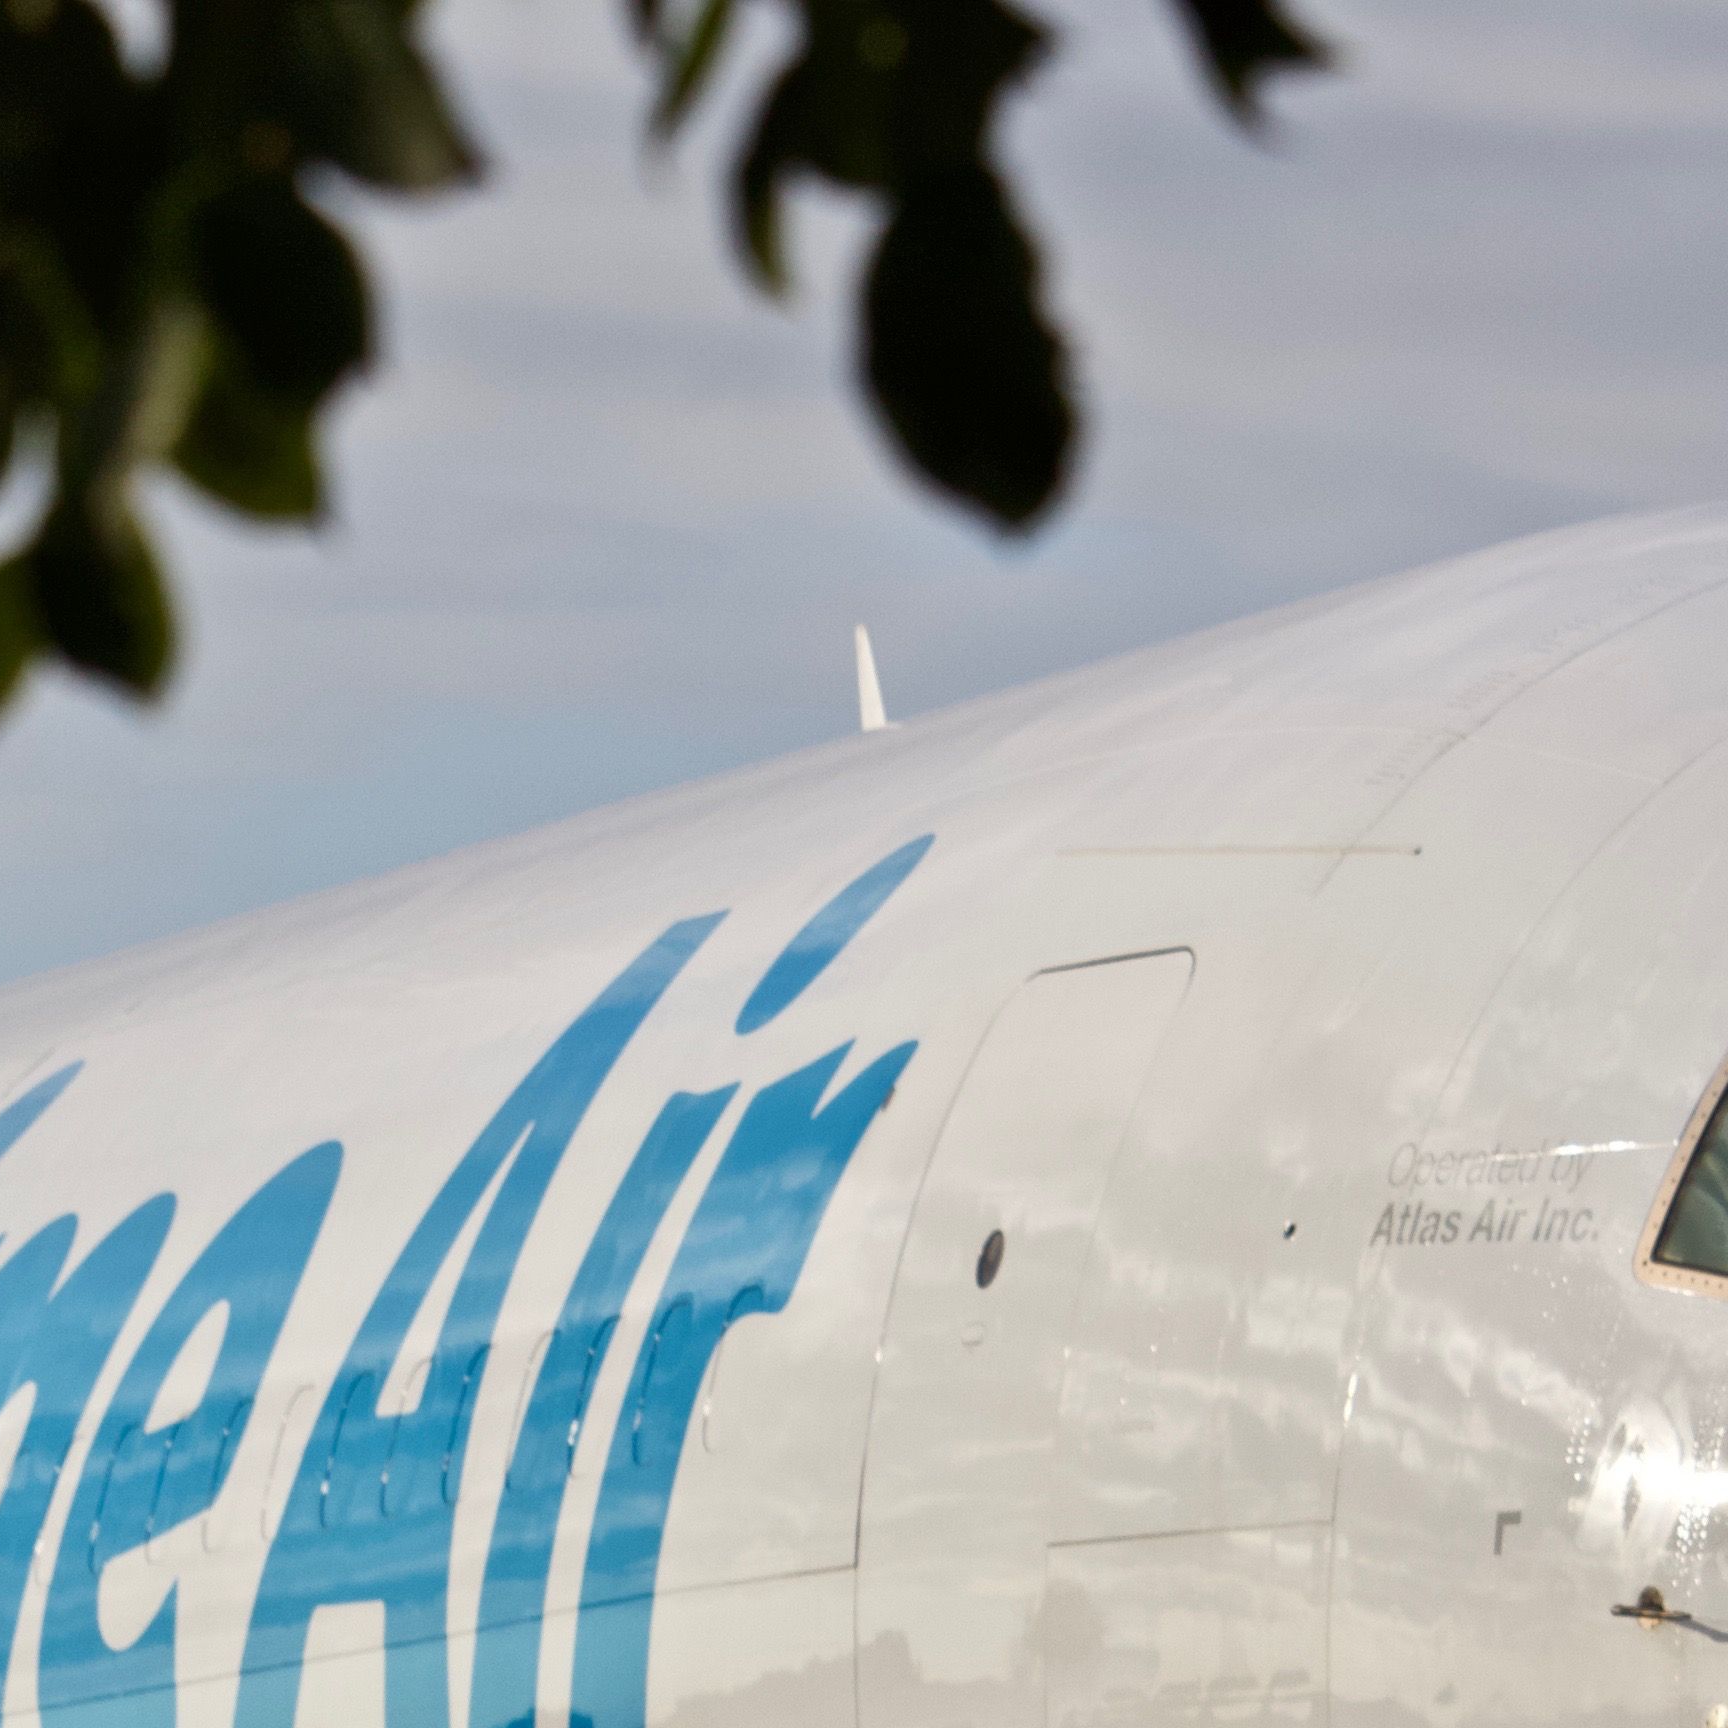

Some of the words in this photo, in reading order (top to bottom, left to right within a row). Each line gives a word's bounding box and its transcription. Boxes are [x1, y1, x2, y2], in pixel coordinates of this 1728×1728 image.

[1369, 1199, 1462, 1247] Atlas
[1469, 1198, 1527, 1243] Air
[1532, 1199, 1599, 1242] Inc.
